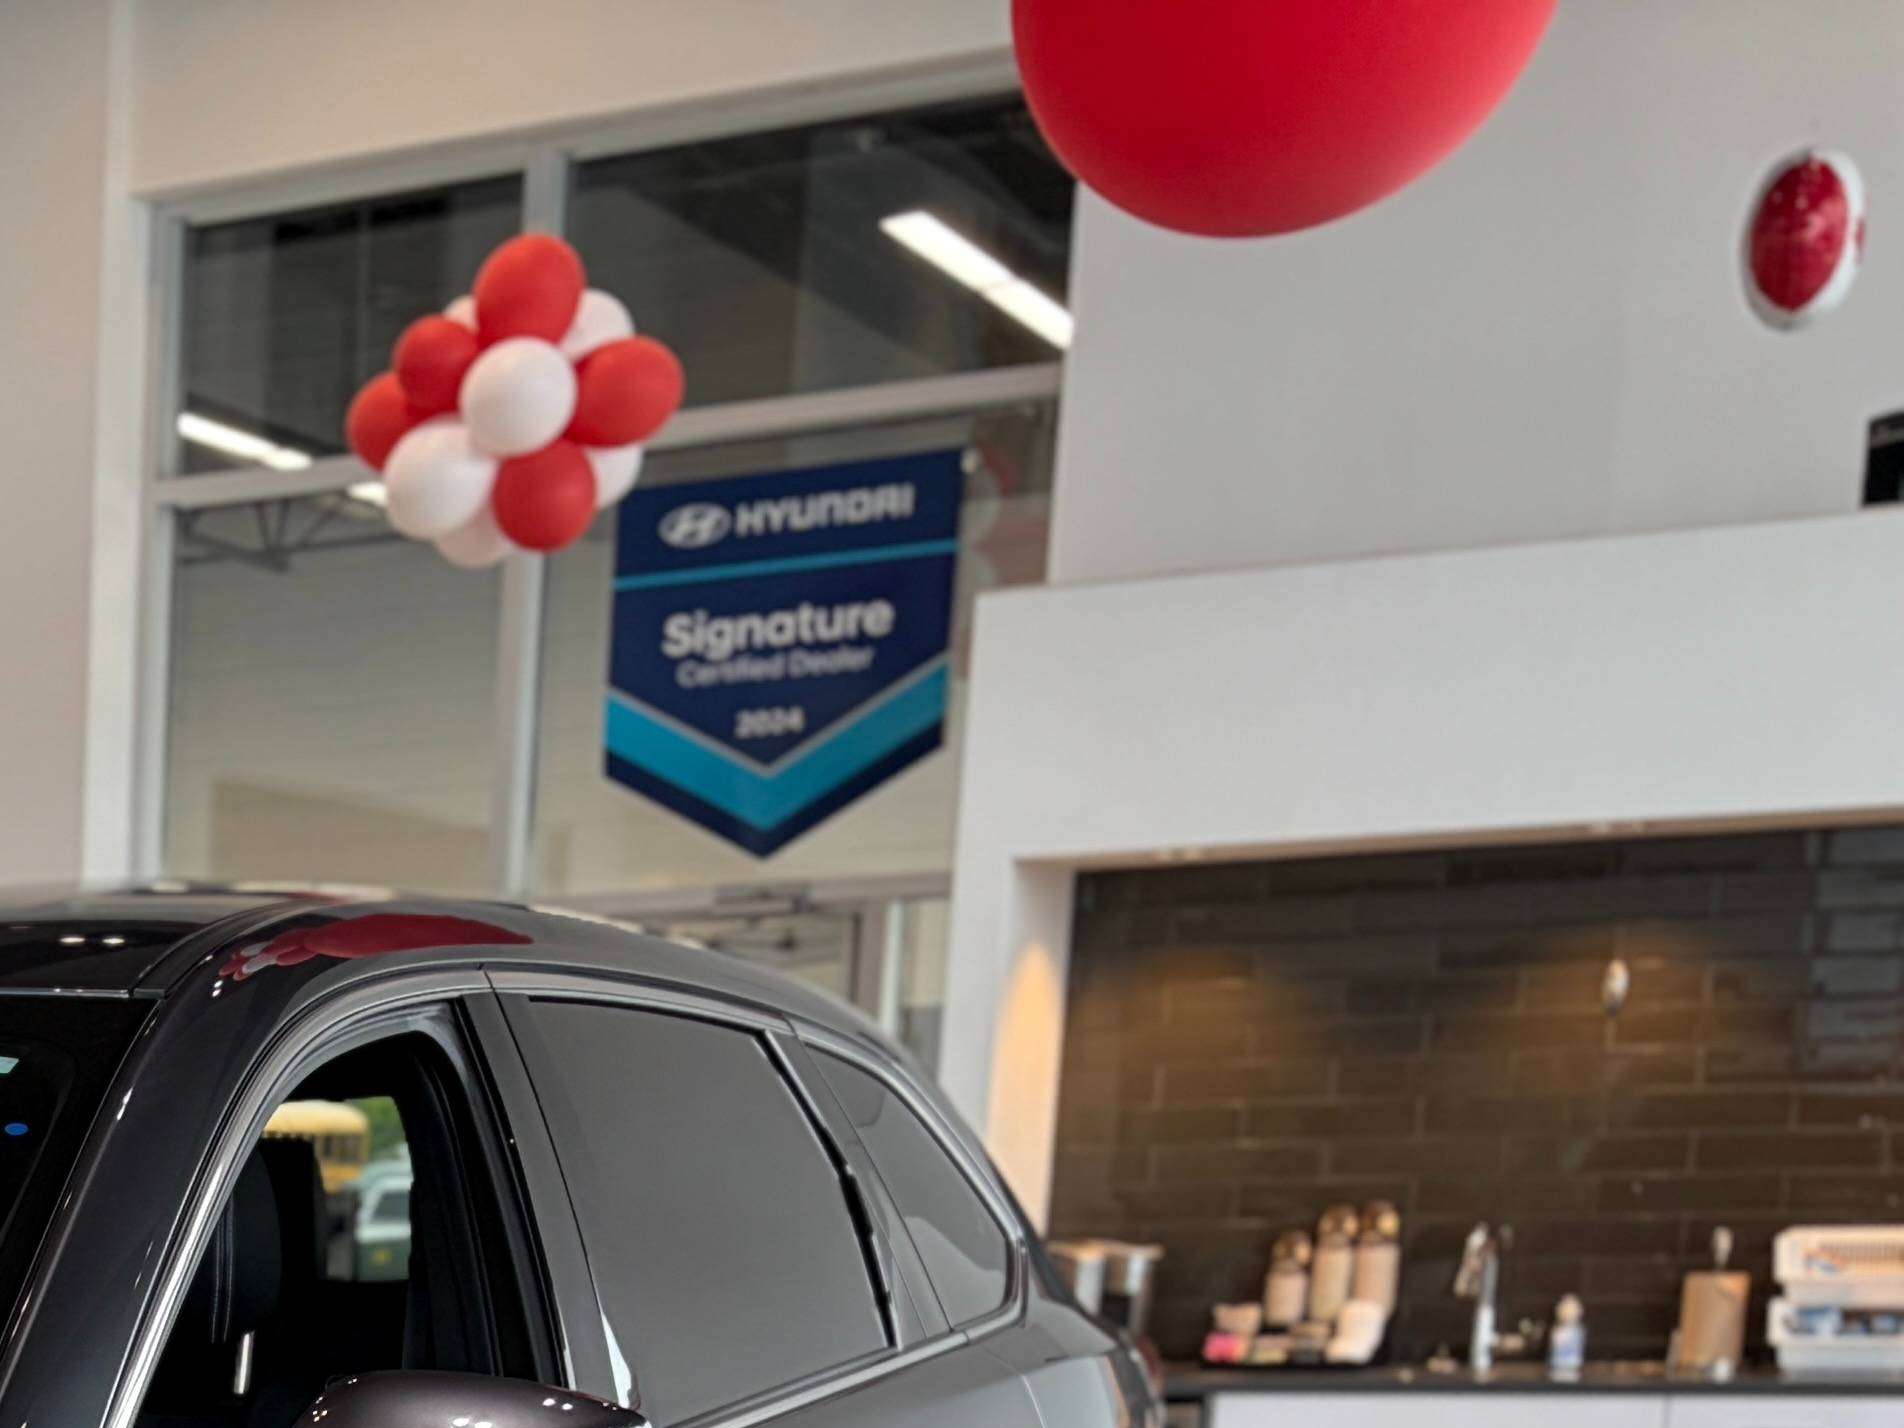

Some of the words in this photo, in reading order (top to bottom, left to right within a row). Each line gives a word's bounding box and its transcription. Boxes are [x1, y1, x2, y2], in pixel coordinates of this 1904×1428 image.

[736, 482, 916, 538] HYUNDAI
[661, 598, 896, 661] Signature
[675, 653, 786, 689] Certified
[789, 645, 876, 679] Dealer
